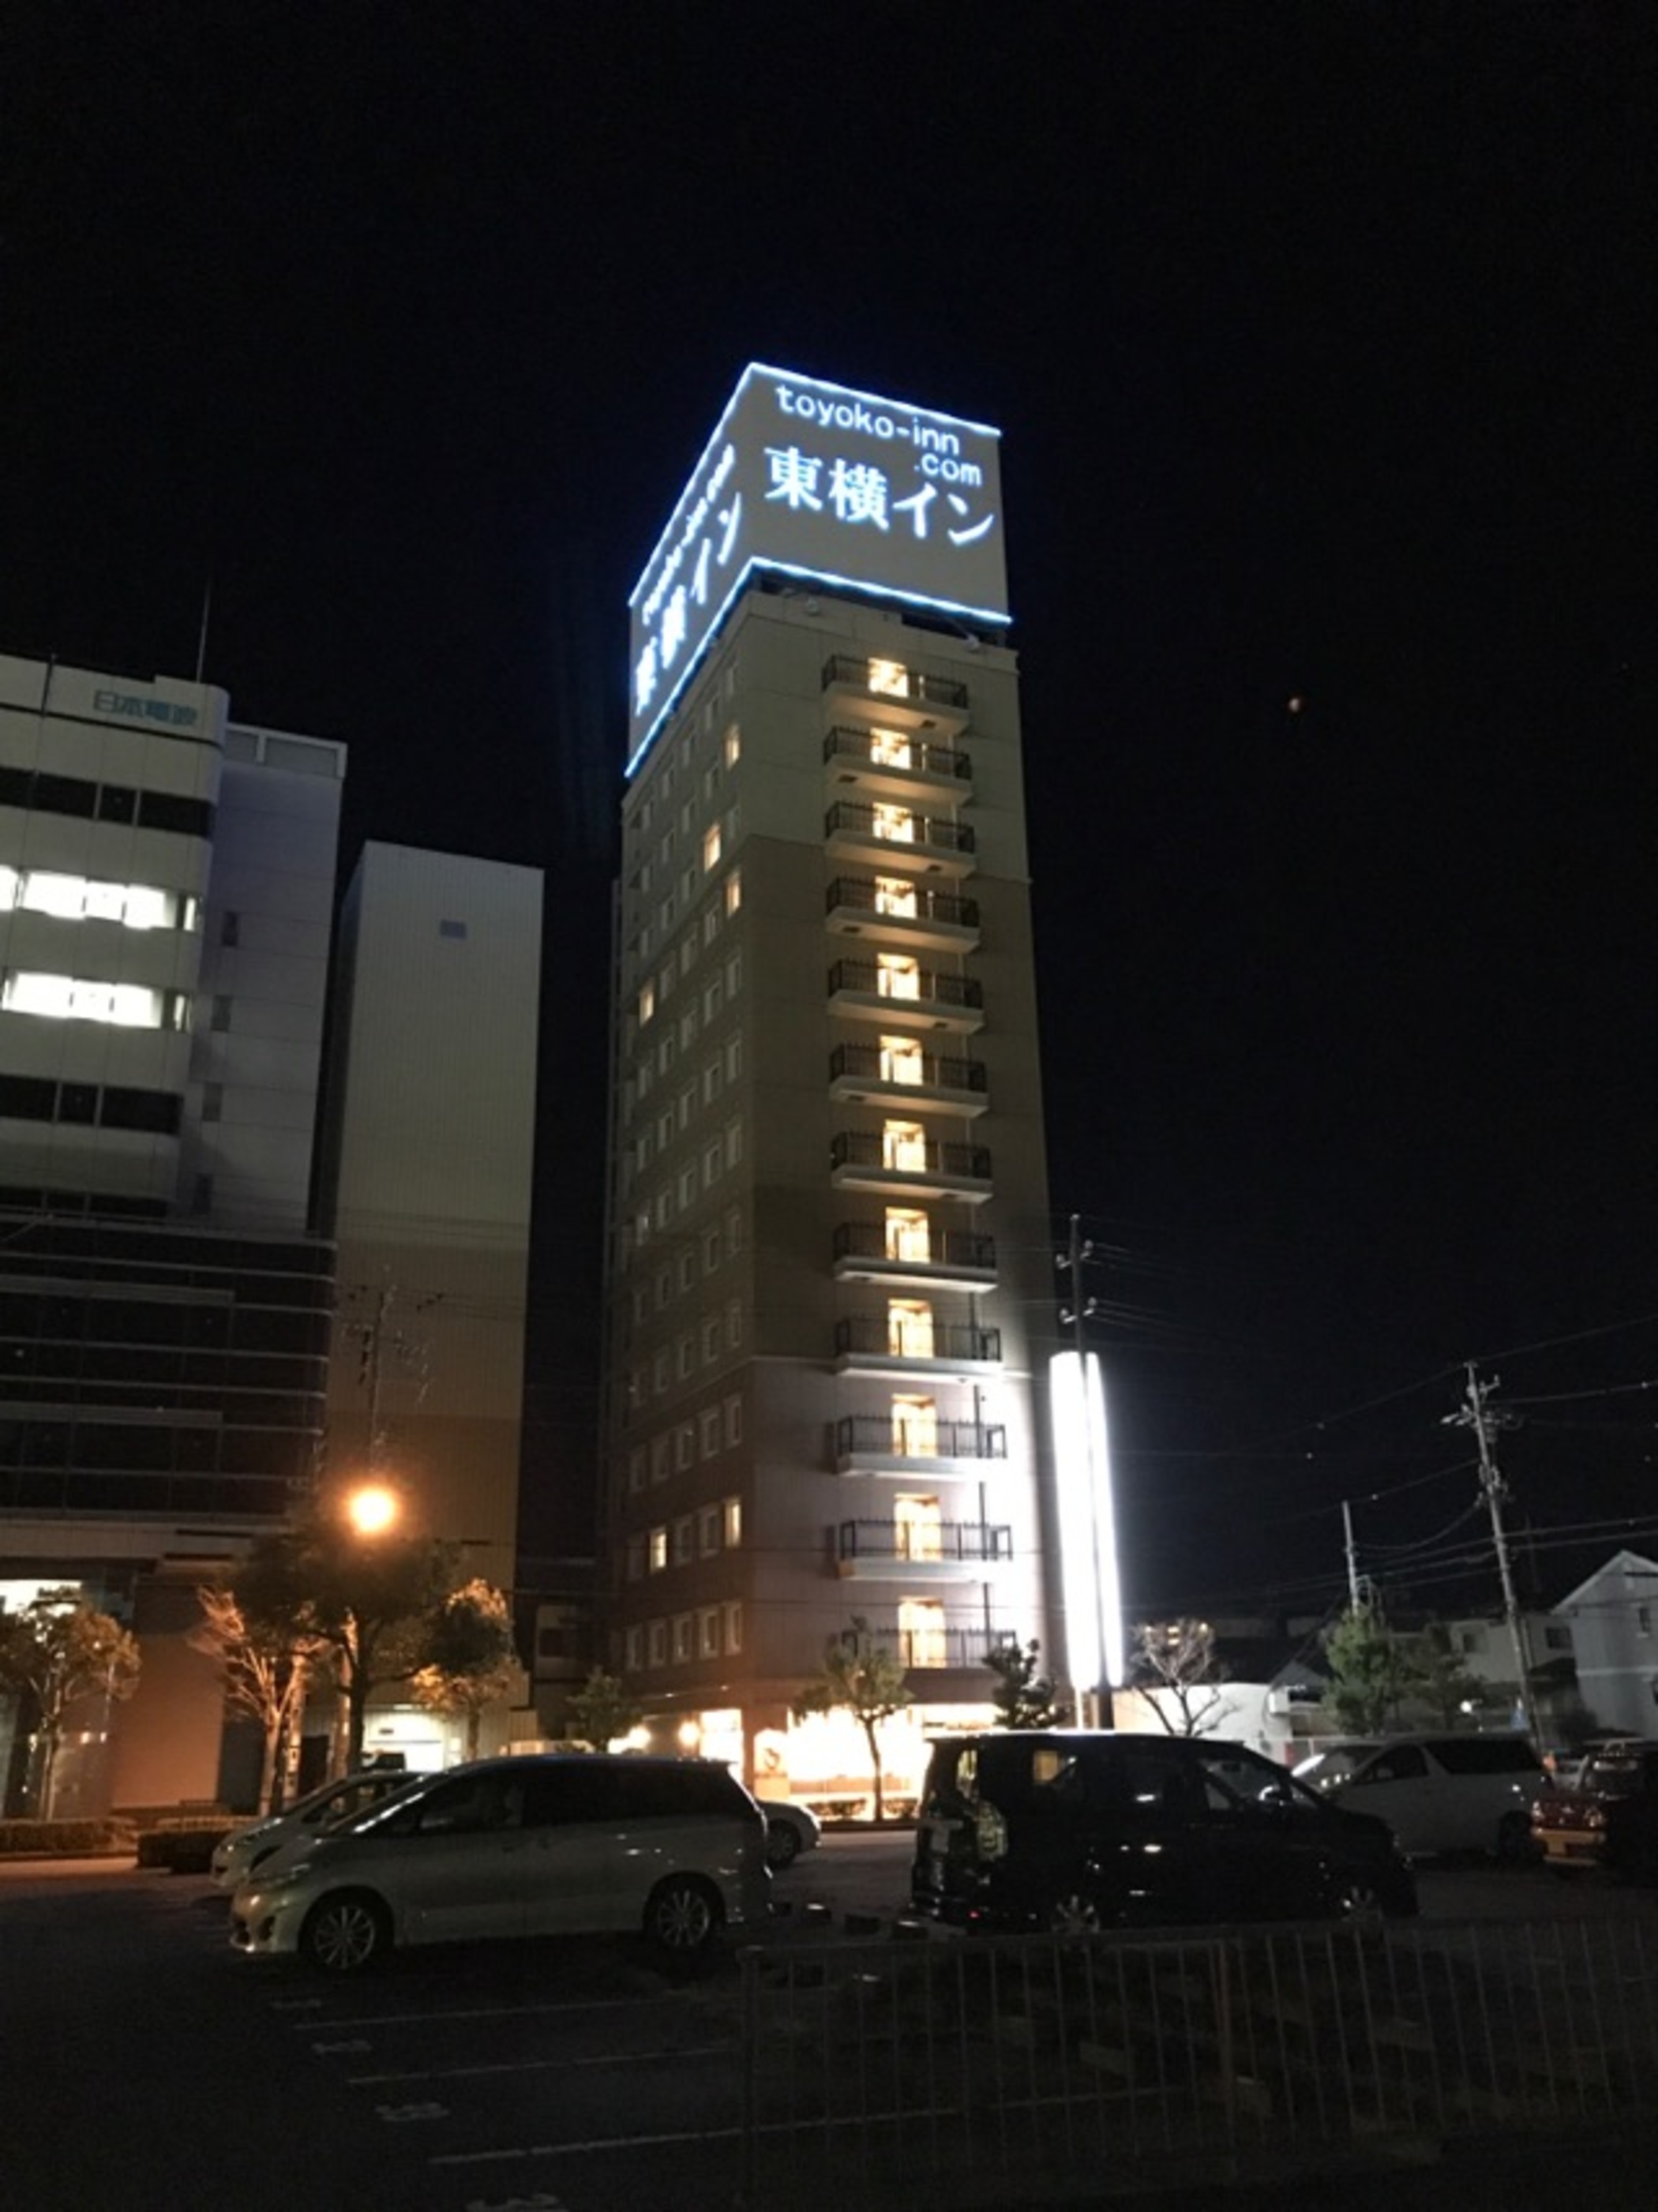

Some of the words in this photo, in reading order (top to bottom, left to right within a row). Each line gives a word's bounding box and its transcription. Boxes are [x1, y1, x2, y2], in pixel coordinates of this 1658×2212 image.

[775, 384, 961, 456] toyoko-inn
[763, 444, 995, 546] 東横イン
